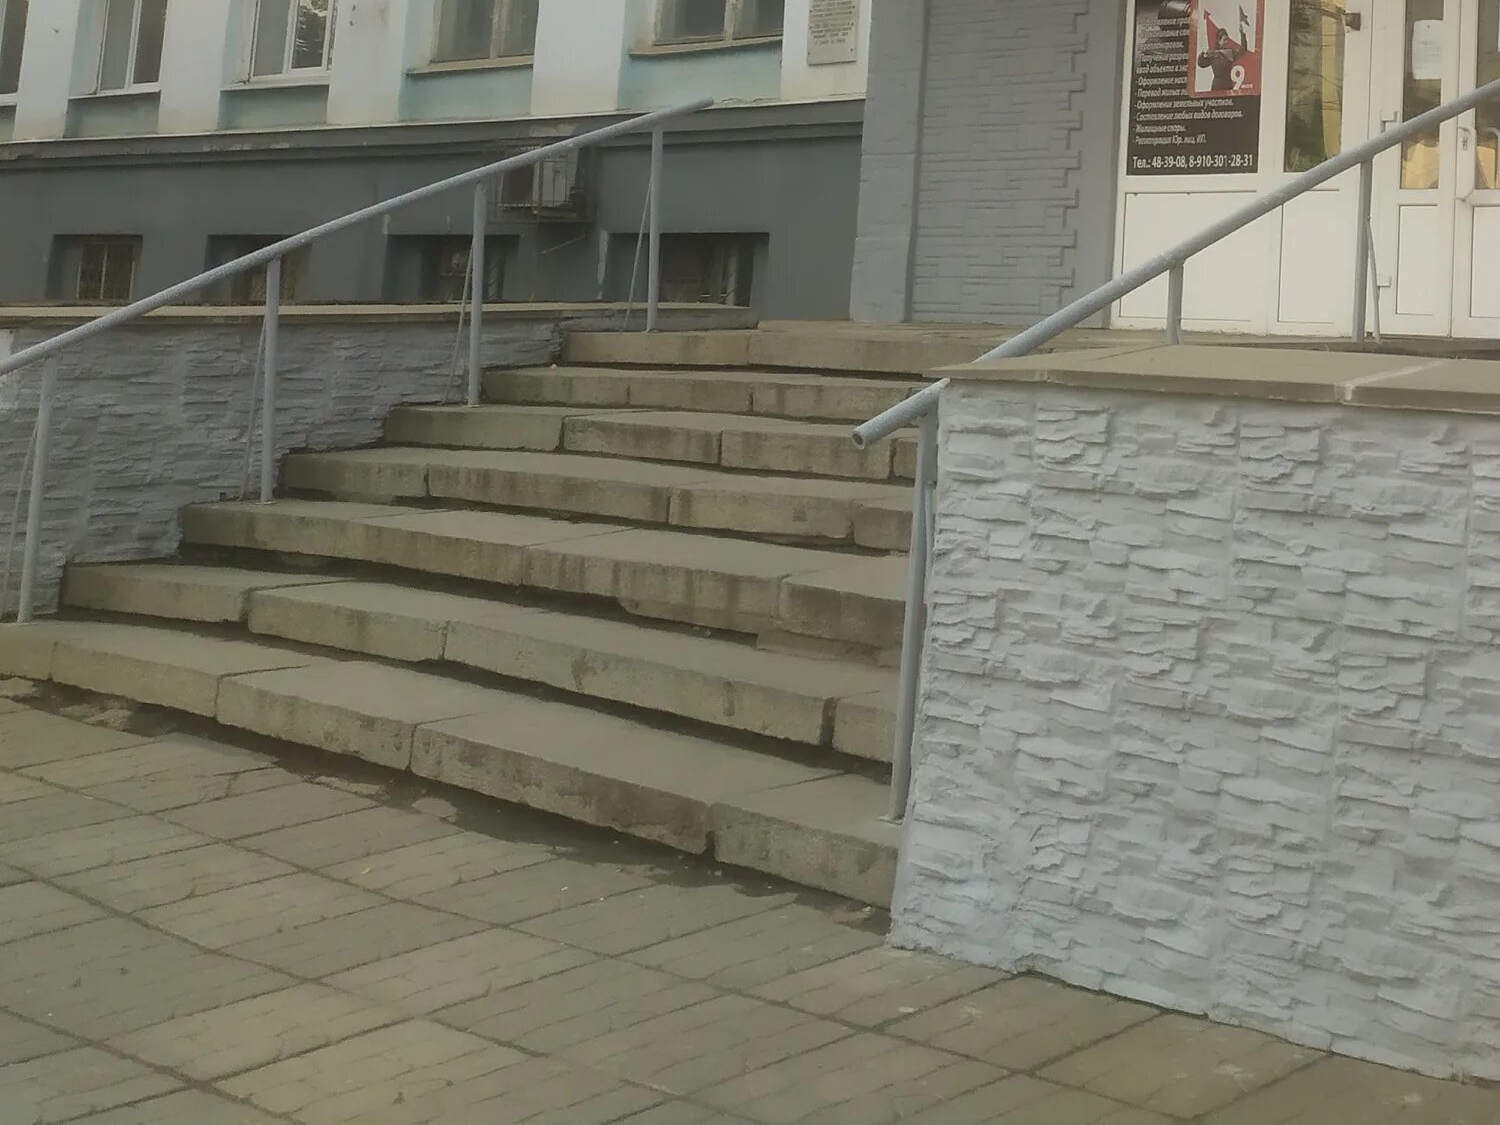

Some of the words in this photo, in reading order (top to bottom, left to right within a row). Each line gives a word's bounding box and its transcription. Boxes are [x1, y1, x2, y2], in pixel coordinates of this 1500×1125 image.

[1230, 65, 1246, 91] 9
[1132, 156, 1151, 169] Тел.:
[1151, 155, 1188, 170] 48-39-08,
[1188, 153, 1254, 169] 8-910-301-28-31
